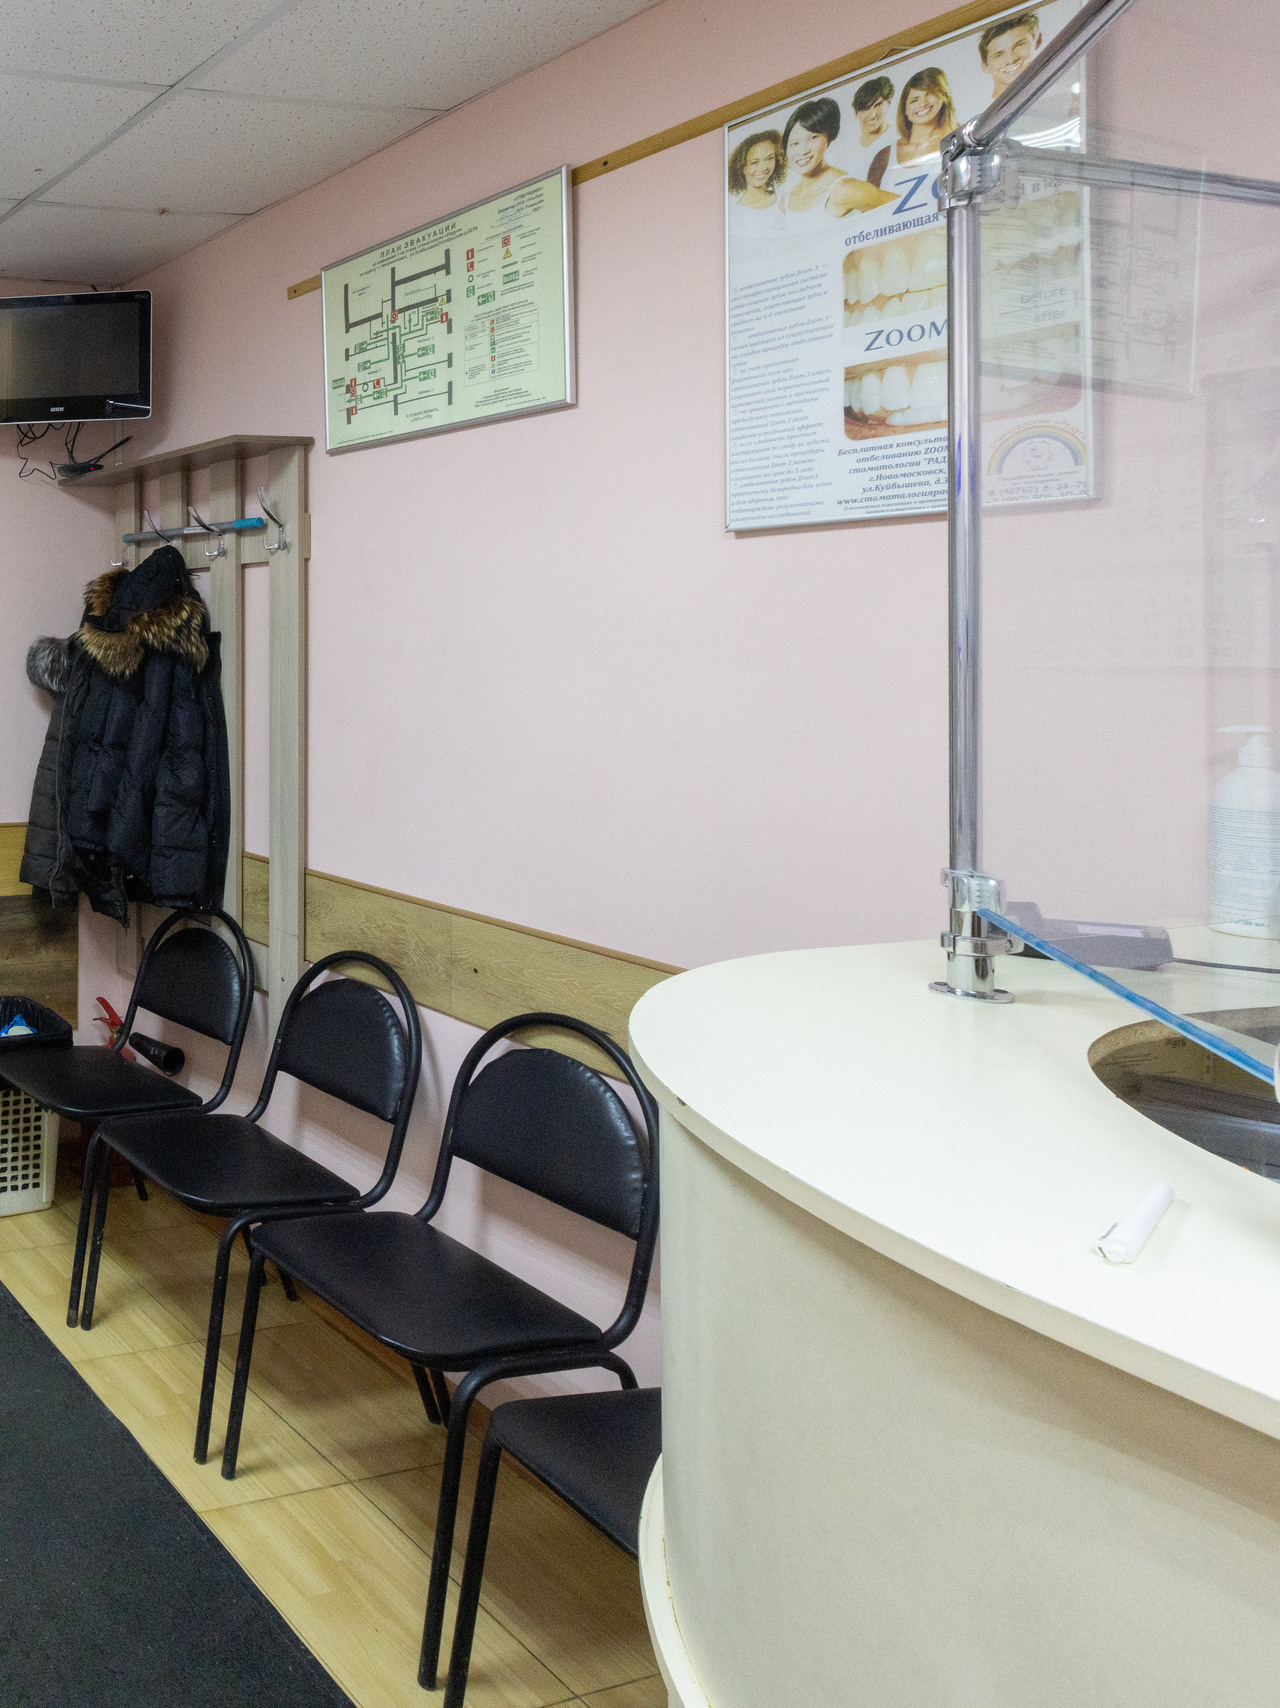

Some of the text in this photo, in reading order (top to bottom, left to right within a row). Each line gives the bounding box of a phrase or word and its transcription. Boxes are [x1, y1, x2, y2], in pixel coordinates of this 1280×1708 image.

[844, 212, 939, 247] отбеливающая
[380, 245, 401, 259] ПЛАН
[404, 222, 456, 249] ЭВАКУАЦИИ
[864, 319, 947, 352] ZOOM
[837, 442, 893, 456] Бесплатная
[856, 448, 921, 463] отбеливанию
[848, 455, 947, 474] стоматологии "РАД
[868, 465, 946, 482] г.Новомосковск,
[861, 478, 931, 494] ул.Куйбышева,
